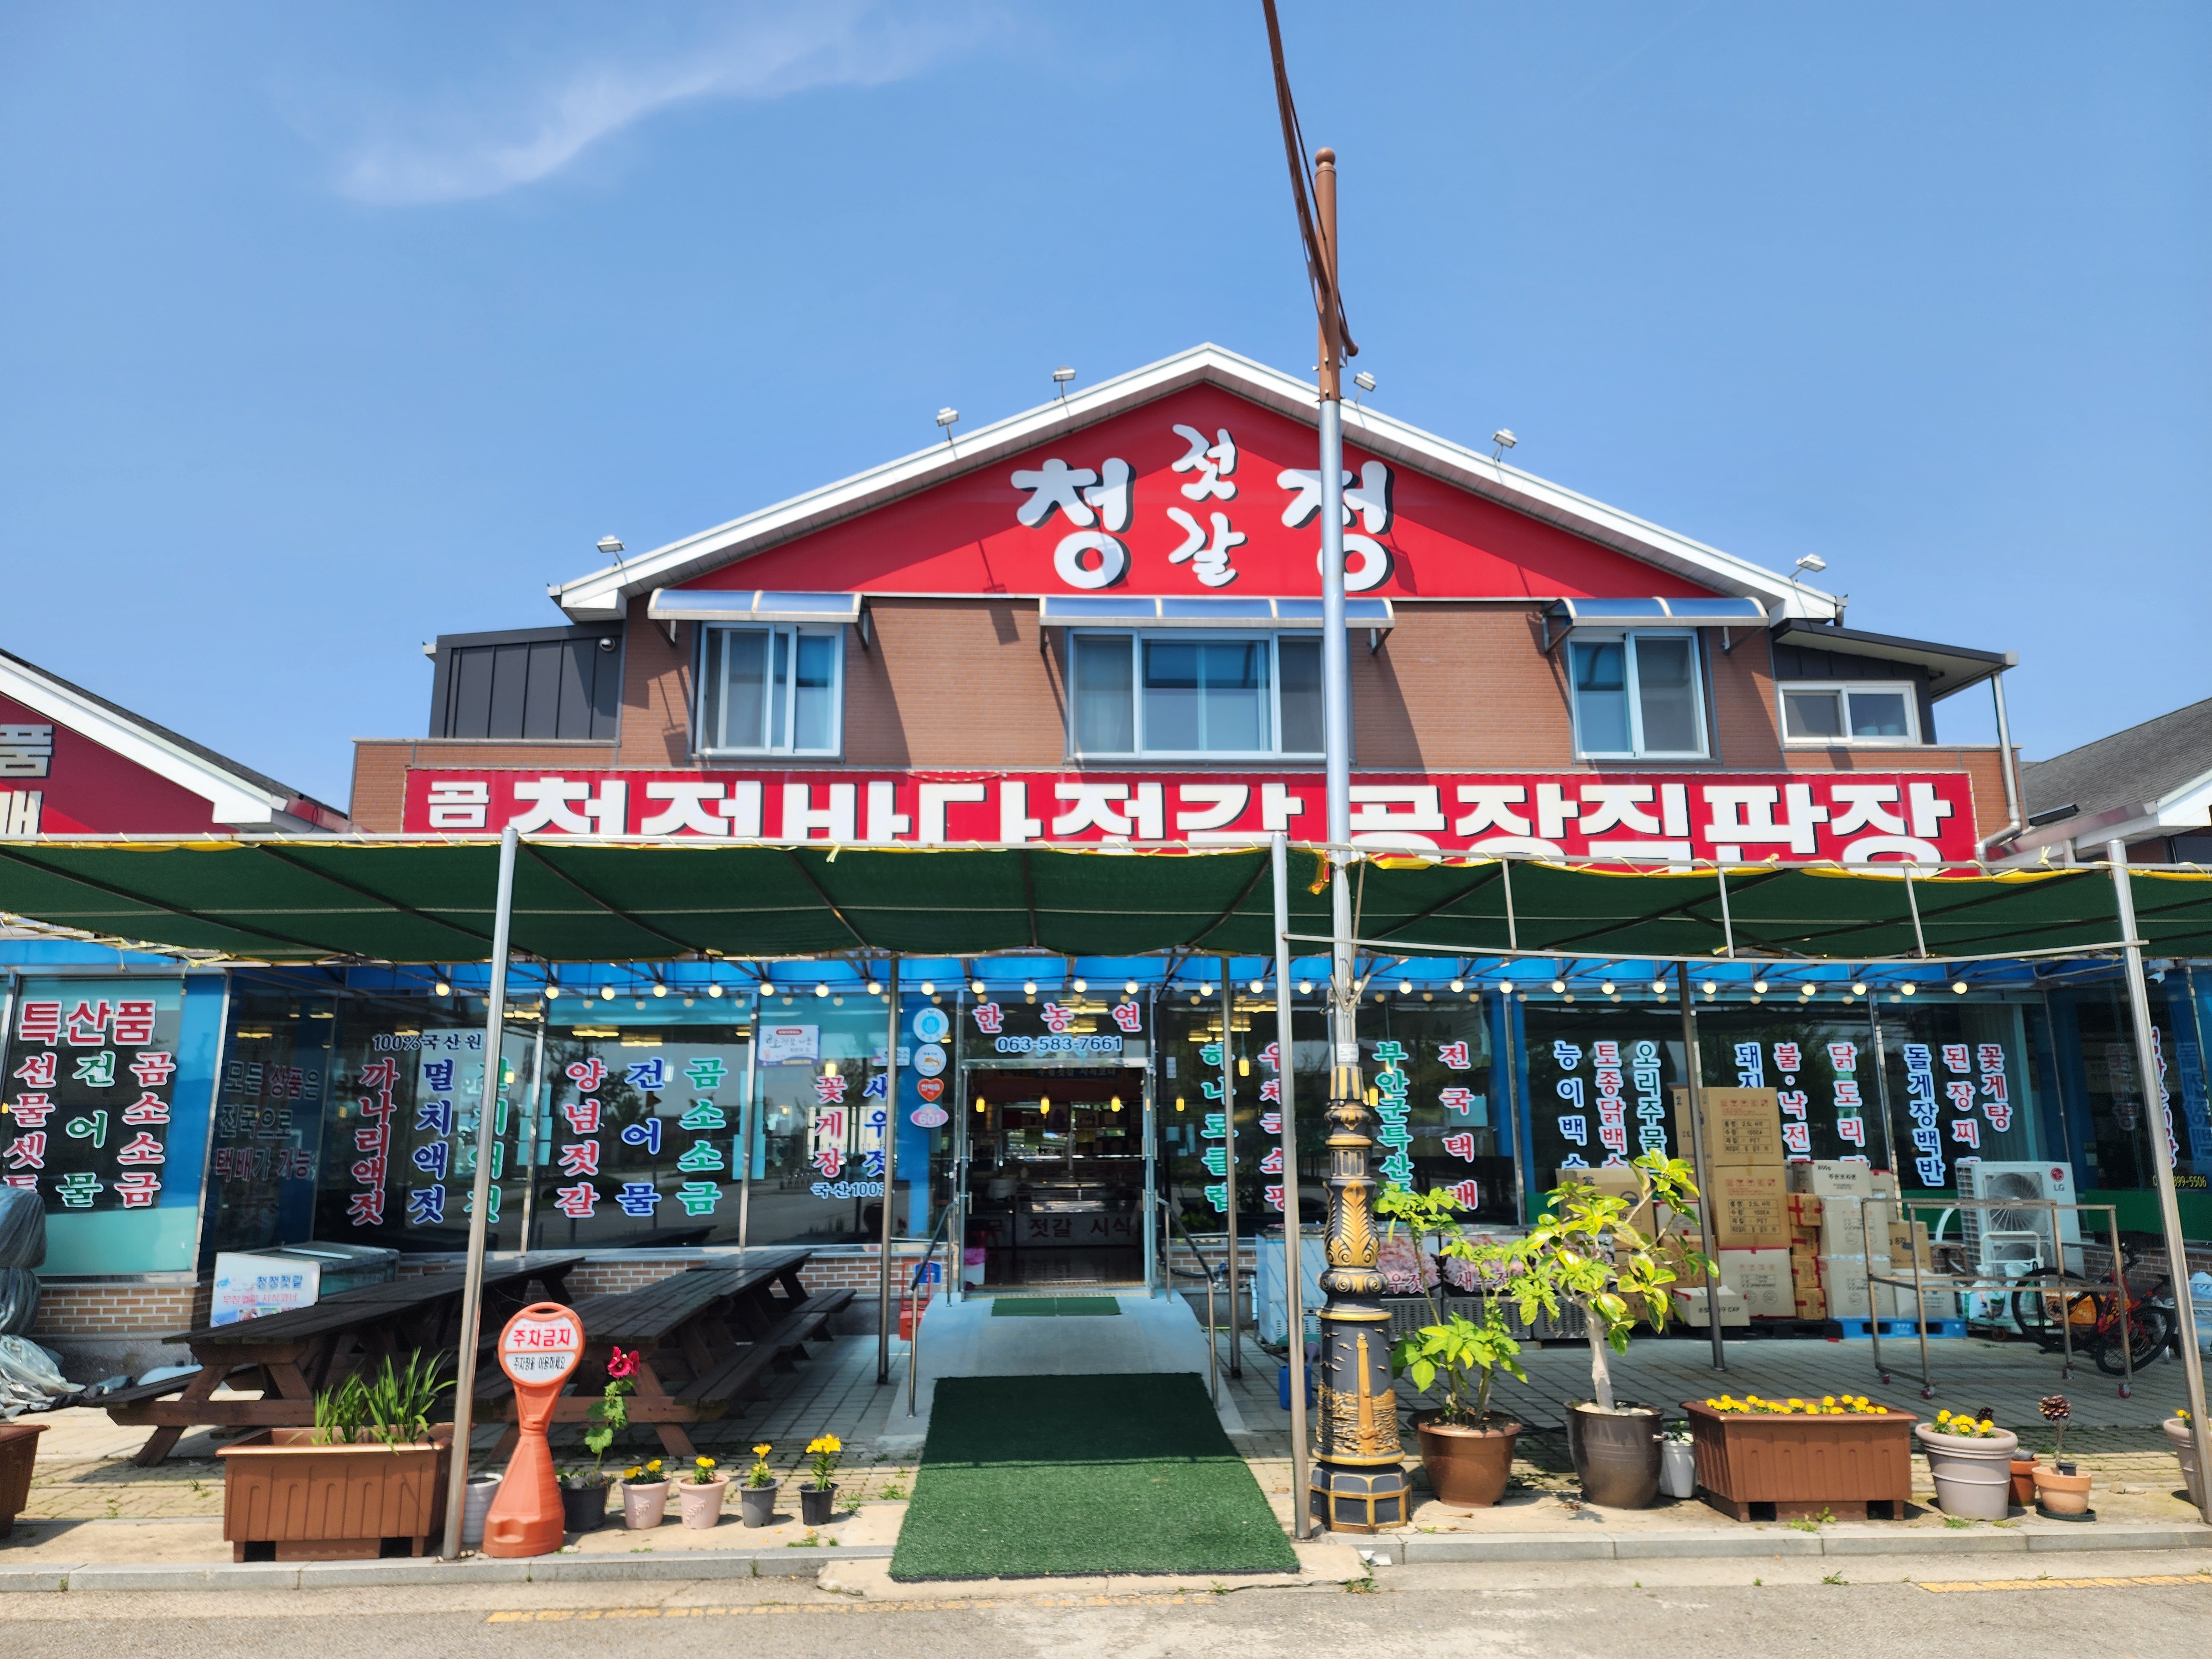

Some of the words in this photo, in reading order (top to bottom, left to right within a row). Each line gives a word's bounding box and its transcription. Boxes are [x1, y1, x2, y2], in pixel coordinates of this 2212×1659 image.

[1167, 424, 1246, 587] 젓갈
[19, 999, 155, 1046] 특산품
[223, 1060, 264, 1096] 모든
[269, 1064, 320, 1100] 상품은
[995, 1036, 1124, 1052] 063-583-7661
[1978, 1044, 2012, 1132] 꽃게탕
[56, 1051, 116, 1208] 건어물
[114, 1051, 176, 1208] 곰소소금
[215, 1146, 271, 1183] 택배가
[277, 1146, 312, 1180] 가능
[220, 1103, 293, 1140] 전국으로
[347, 1057, 400, 1227] 까나리액젓
[408, 1057, 455, 1224] 멸치액젓
[554, 1057, 607, 1218] 양념젓갈
[614, 1056, 666, 1217] 건어물
[675, 1057, 728, 1217] 곰소소금
[813, 1074, 848, 1178] 꽃게장
[1372, 1041, 1415, 1195] 부안군특산
[1438, 1040, 1479, 1210] 전국택배
[1633, 1041, 1668, 1178] 오리주물
[1828, 1042, 1871, 1168] 닭도리
[1904, 1044, 1945, 1187] 돌게장백반
[1942, 1044, 1982, 1164] 된장찌
[514, 1328, 571, 1348] 주차금지
[1388, 1272, 1426, 1294] 우젓
[514, 1356, 535, 1371] 주차장을
[538, 1356, 566, 1370] 이용하세요
